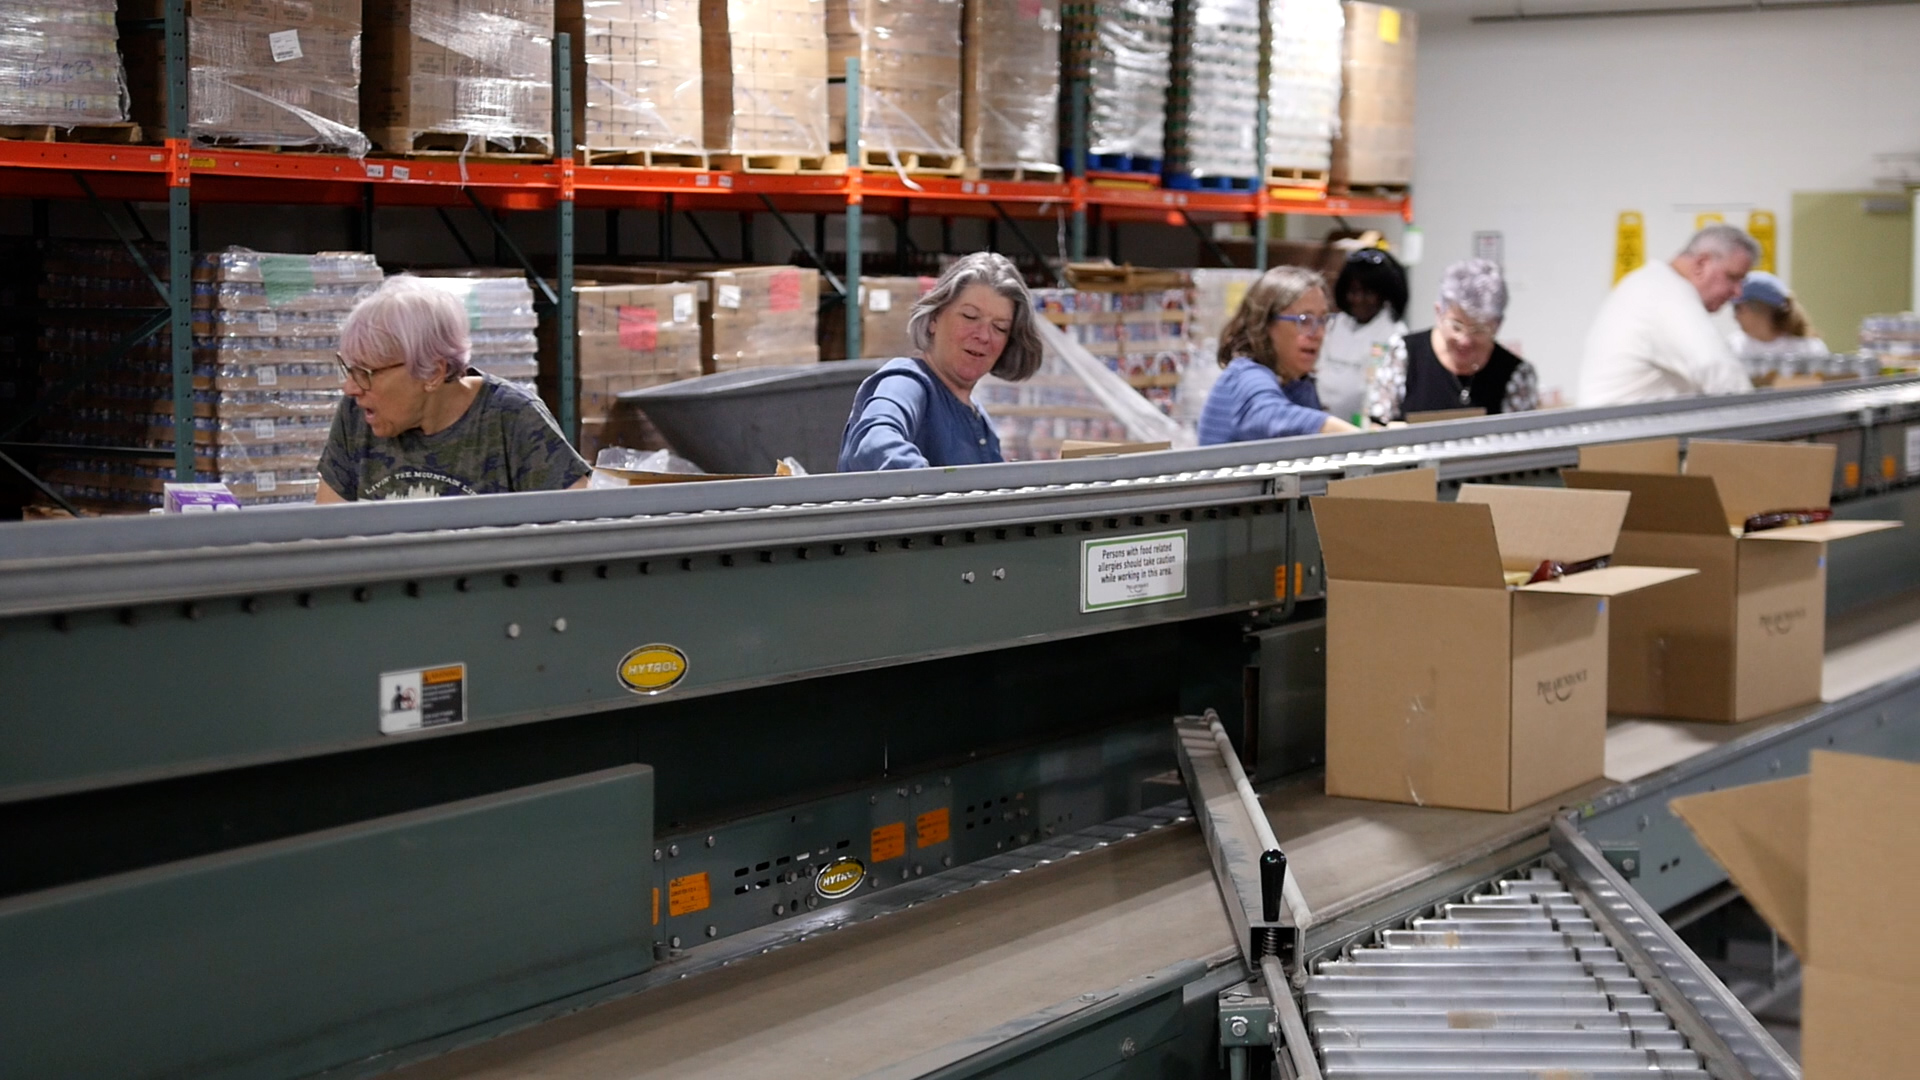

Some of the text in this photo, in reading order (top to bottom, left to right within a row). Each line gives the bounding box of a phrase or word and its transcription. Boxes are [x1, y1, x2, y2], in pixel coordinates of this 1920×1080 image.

[394, 471, 412, 480] THE
[413, 471, 461, 487] MOUNTAIN
[1102, 543, 1172, 559] Persons with food related
[1098, 554, 1175, 573] allergies should take caution
[1101, 567, 1172, 583] while working in this area.
[627, 661, 678, 676] HYTROL
